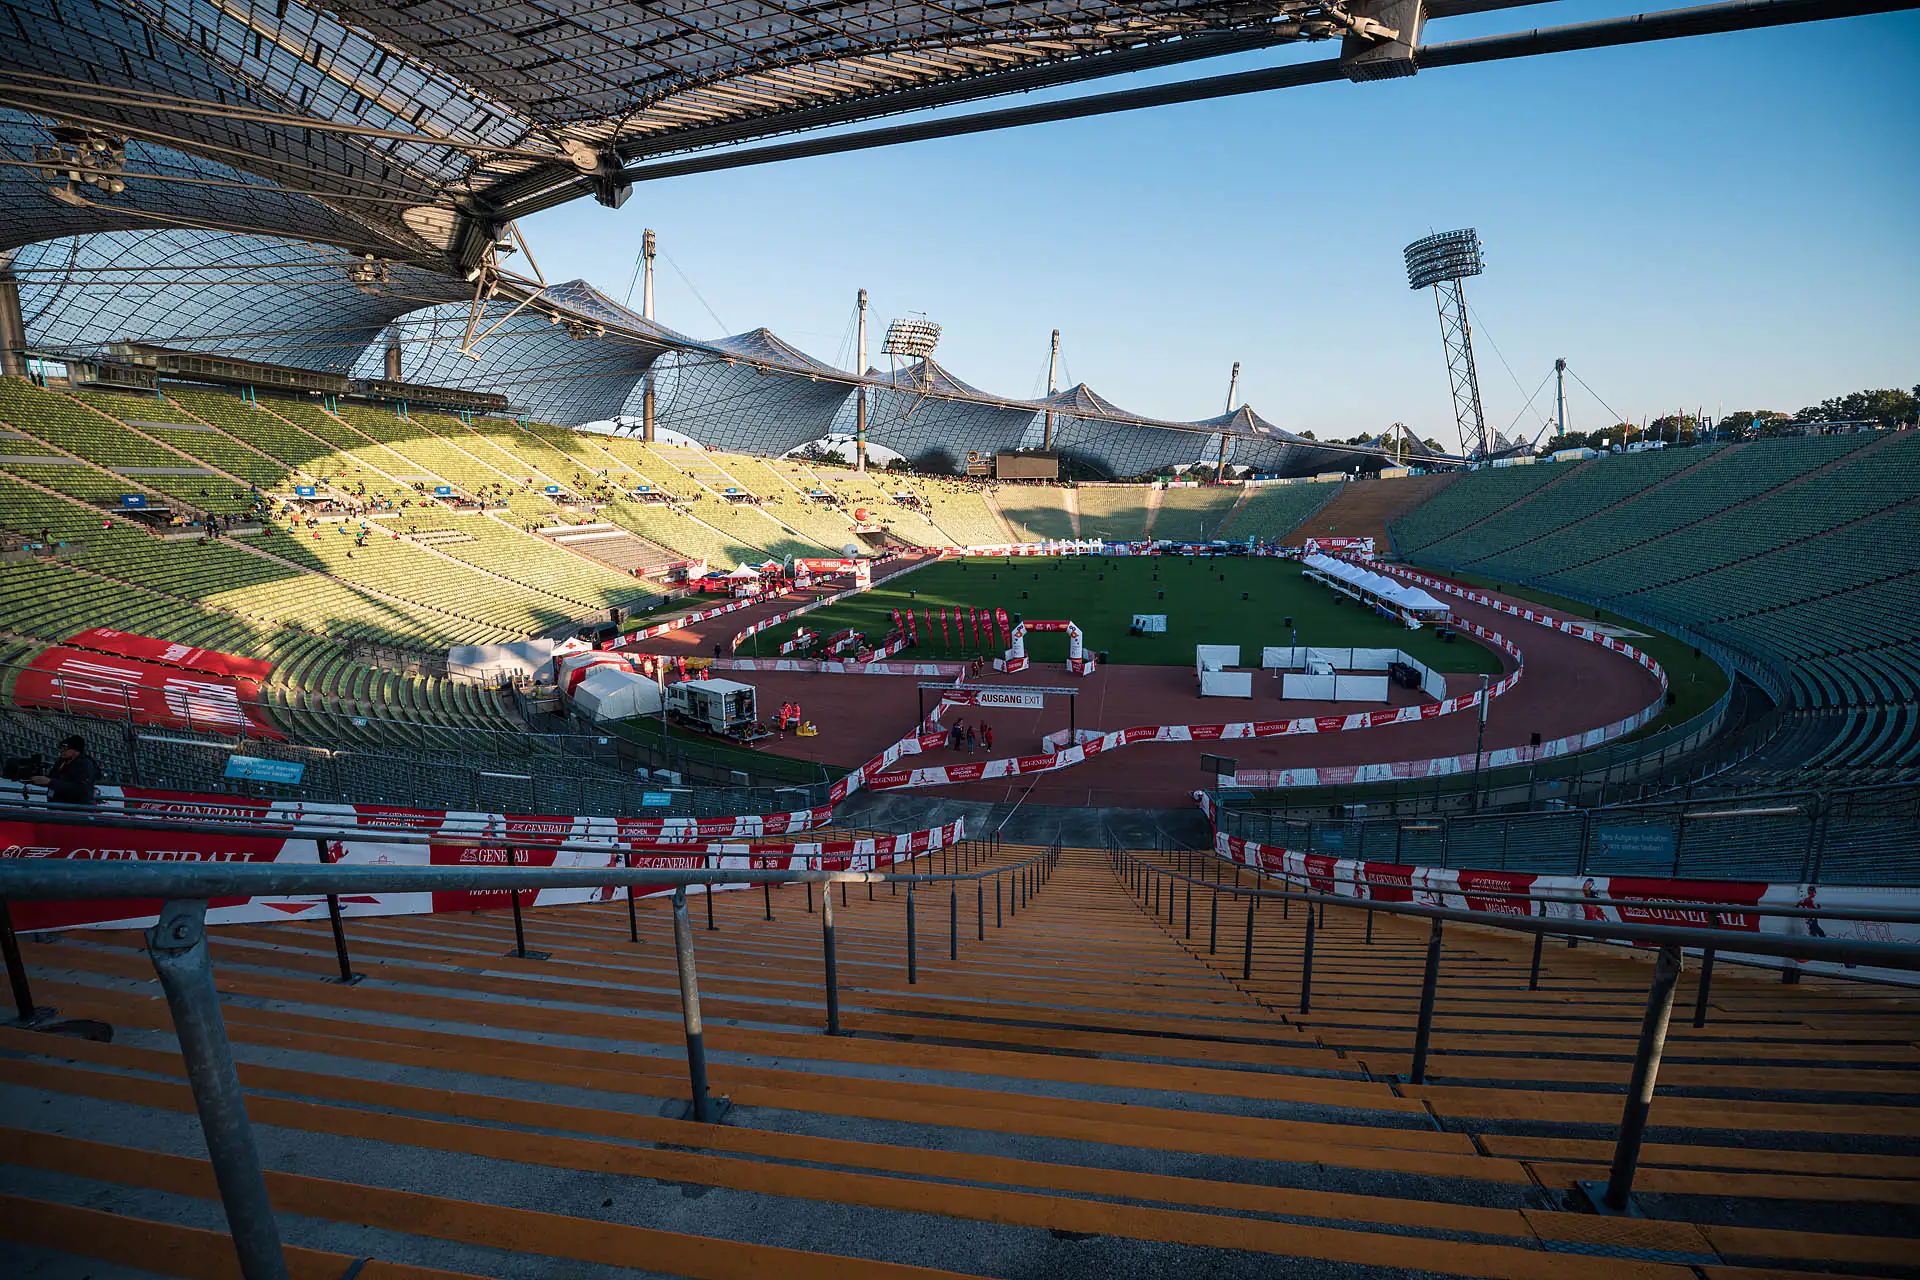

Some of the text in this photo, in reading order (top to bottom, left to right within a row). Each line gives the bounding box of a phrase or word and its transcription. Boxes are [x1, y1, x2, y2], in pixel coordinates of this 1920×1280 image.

[1331, 539, 1348, 547] RUN!
[821, 560, 841, 568] FINISH
[981, 694, 1041, 705] AUSGANG EXIT
[878, 774, 908, 784] GENERALI
[524, 823, 568, 834] GENERALI
[478, 848, 529, 863] GENEALI
[652, 856, 700, 868] GENERALI
